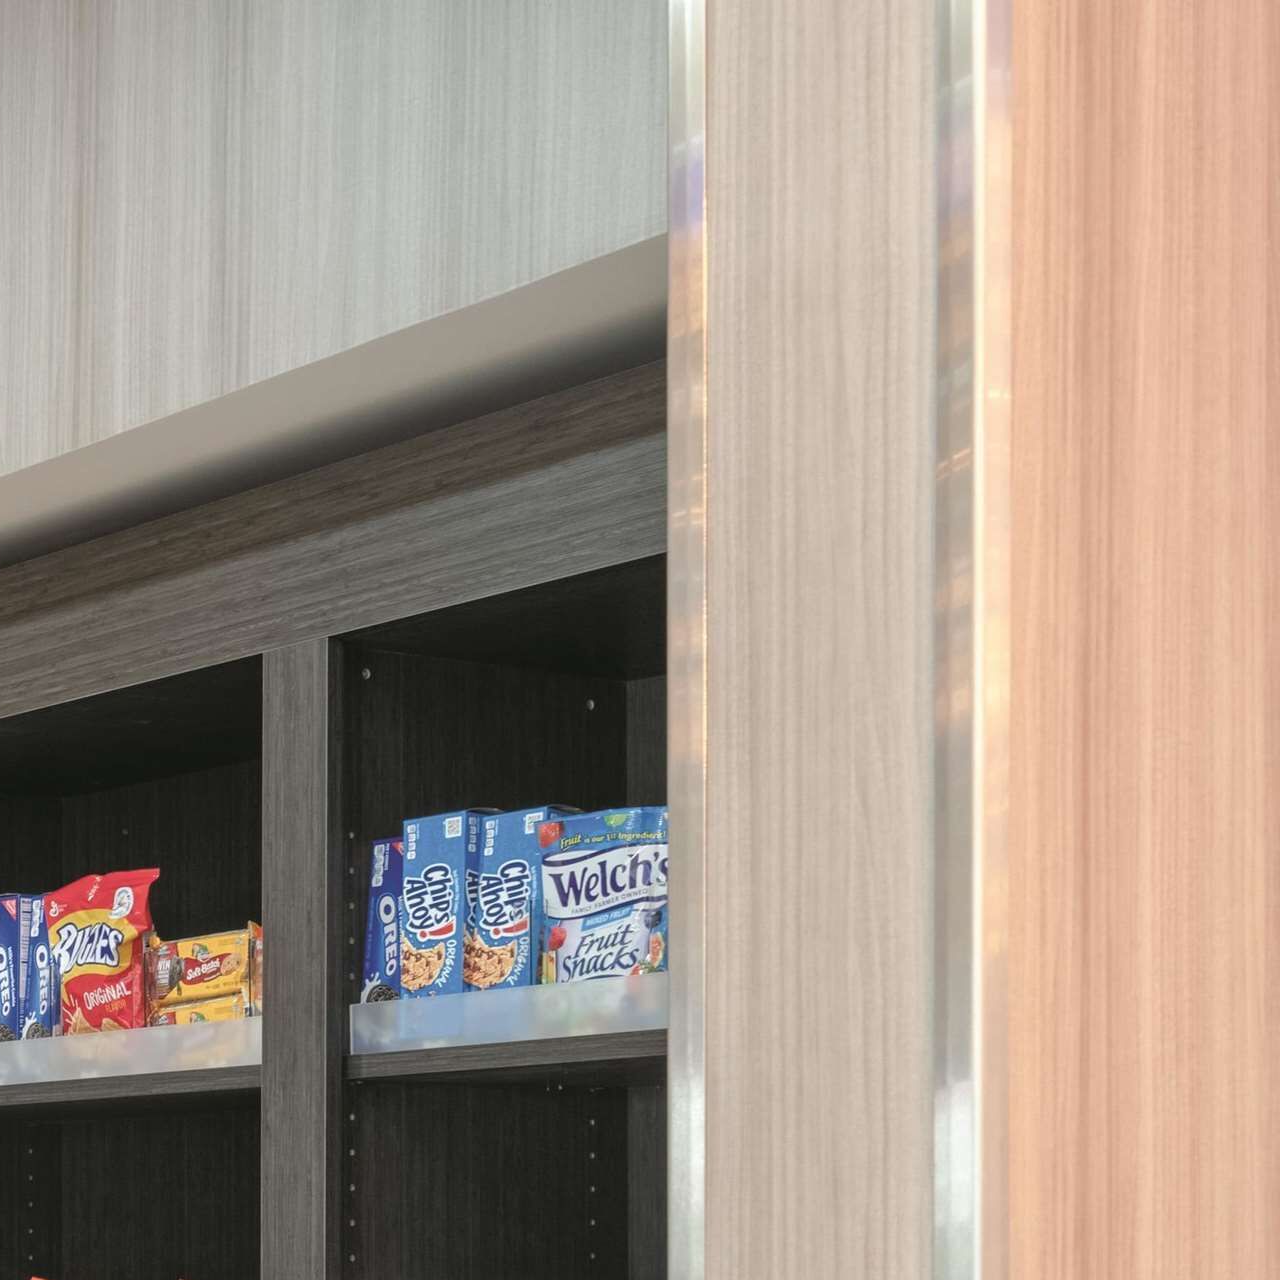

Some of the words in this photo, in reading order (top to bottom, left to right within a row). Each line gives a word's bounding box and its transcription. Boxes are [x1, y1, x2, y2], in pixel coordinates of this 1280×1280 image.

[560, 834, 582, 852] Fruit
[423, 864, 452, 925] Chips
[500, 860, 530, 922] Chips
[379, 895, 397, 976] OREO
[562, 947, 640, 983] Snacks
[575, 923, 634, 960] Fruit
[35, 944, 48, 1015] OREO
